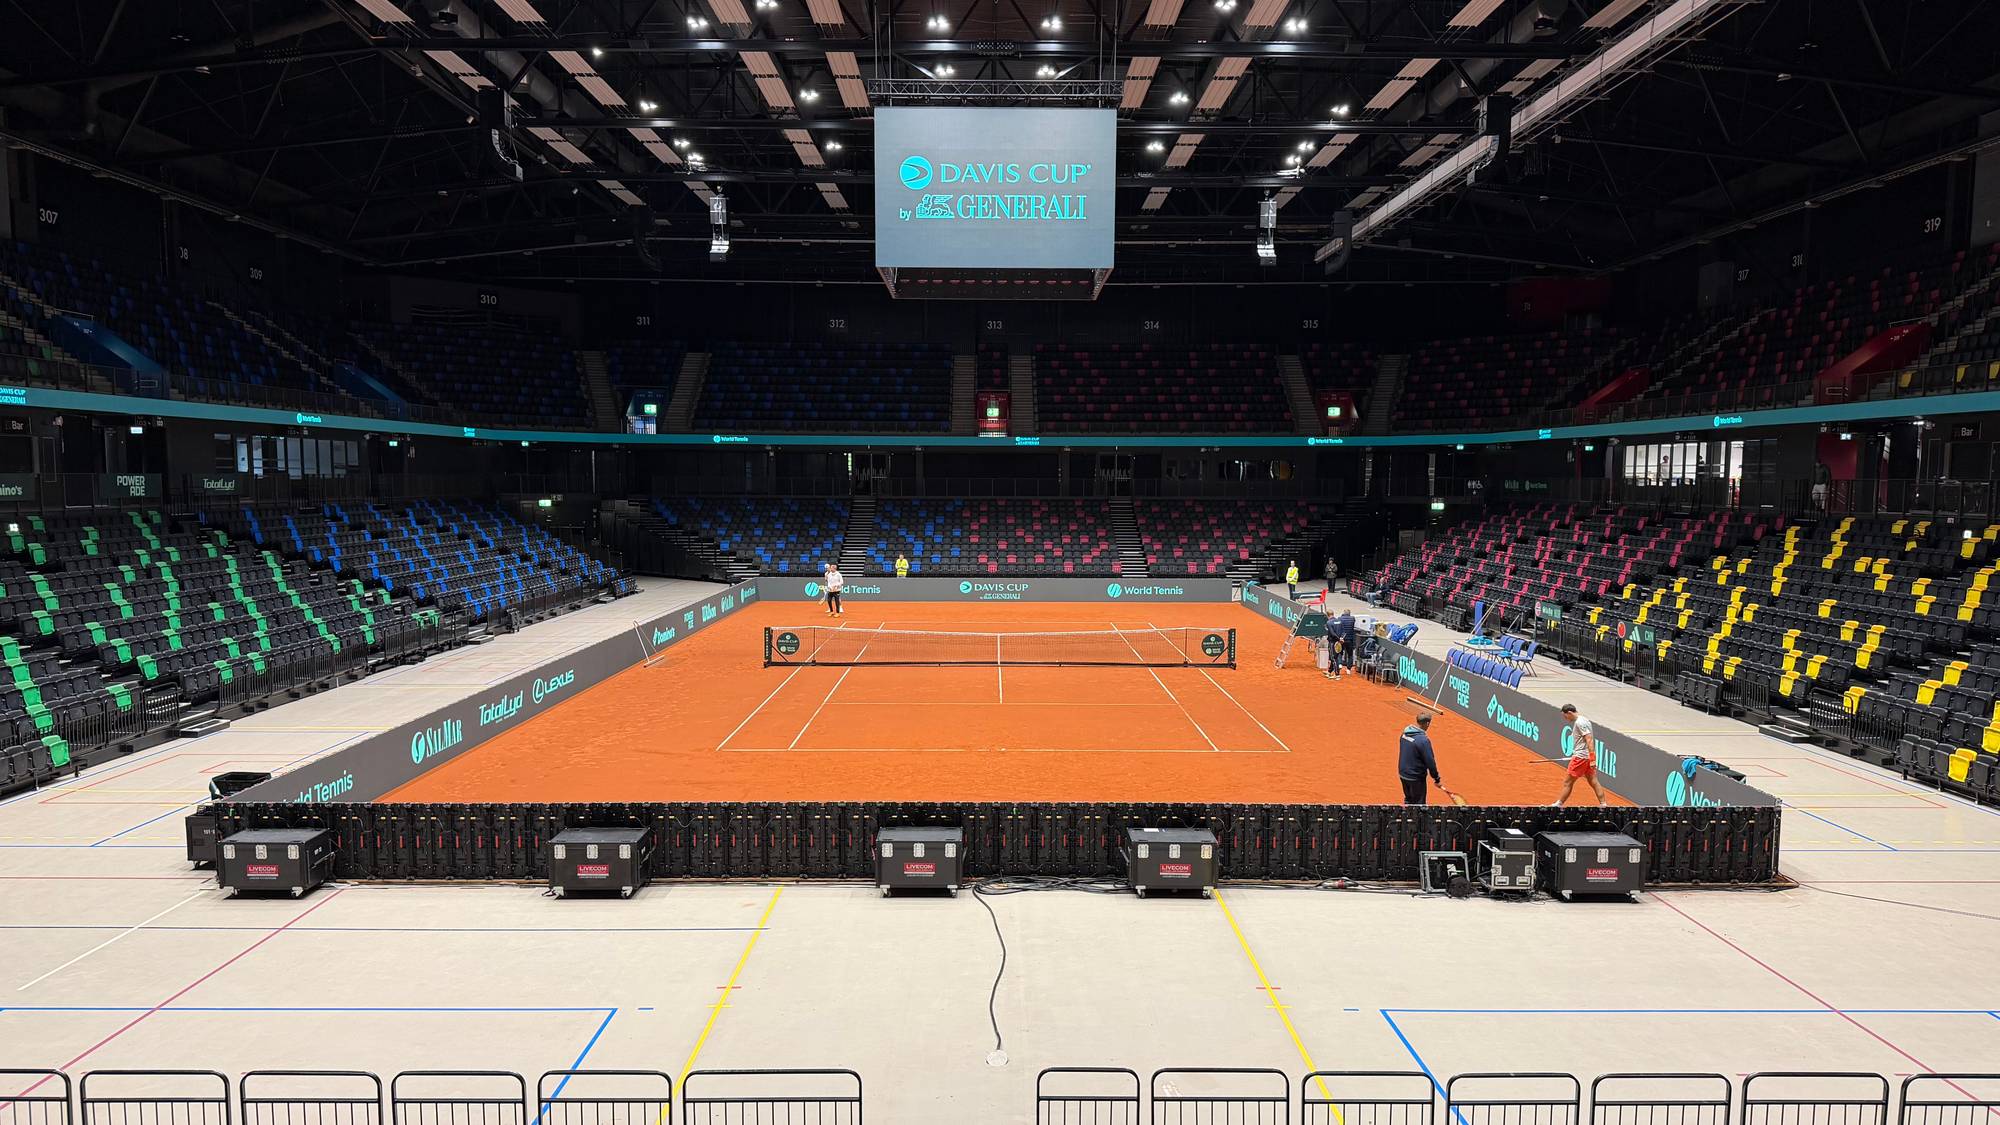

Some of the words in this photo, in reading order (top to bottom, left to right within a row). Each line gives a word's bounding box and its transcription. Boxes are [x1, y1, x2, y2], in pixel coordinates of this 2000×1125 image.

[940, 163, 1020, 184] DAVIS
[899, 208, 912, 221] by
[956, 194, 1087, 220] GENERALI
[39, 207, 58, 225] 307
[1924, 217, 1941, 233] 319
[250, 266, 263, 280] 309
[480, 294, 497, 305] 310
[636, 316, 650, 326] 311
[829, 319, 845, 329] 312
[986, 320, 1003, 330] 313
[1144, 320, 1160, 330] 314
[1303, 319, 1319, 329] 315
[11, 420, 24, 430] Bar
[1961, 427, 1974, 437] Bar
[116, 475, 146, 486] POWER
[202, 478, 235, 491] TotalLyd
[130, 486, 146, 497] ADE
[852, 585, 881, 594] Tennis
[974, 583, 1004, 592] DAVIS
[1006, 583, 1029, 592] CUP
[1124, 585, 1152, 595] World
[1154, 585, 1184, 595] Tennis
[1400, 656, 1429, 689] Wilson
[544, 669, 575, 694] LEXUS
[1449, 675, 1470, 696] POWER
[1457, 692, 1470, 709] ADE
[479, 690, 523, 727] TotalLyd
[1496, 705, 1540, 742] Domino's
[314, 770, 353, 803] Tennis
